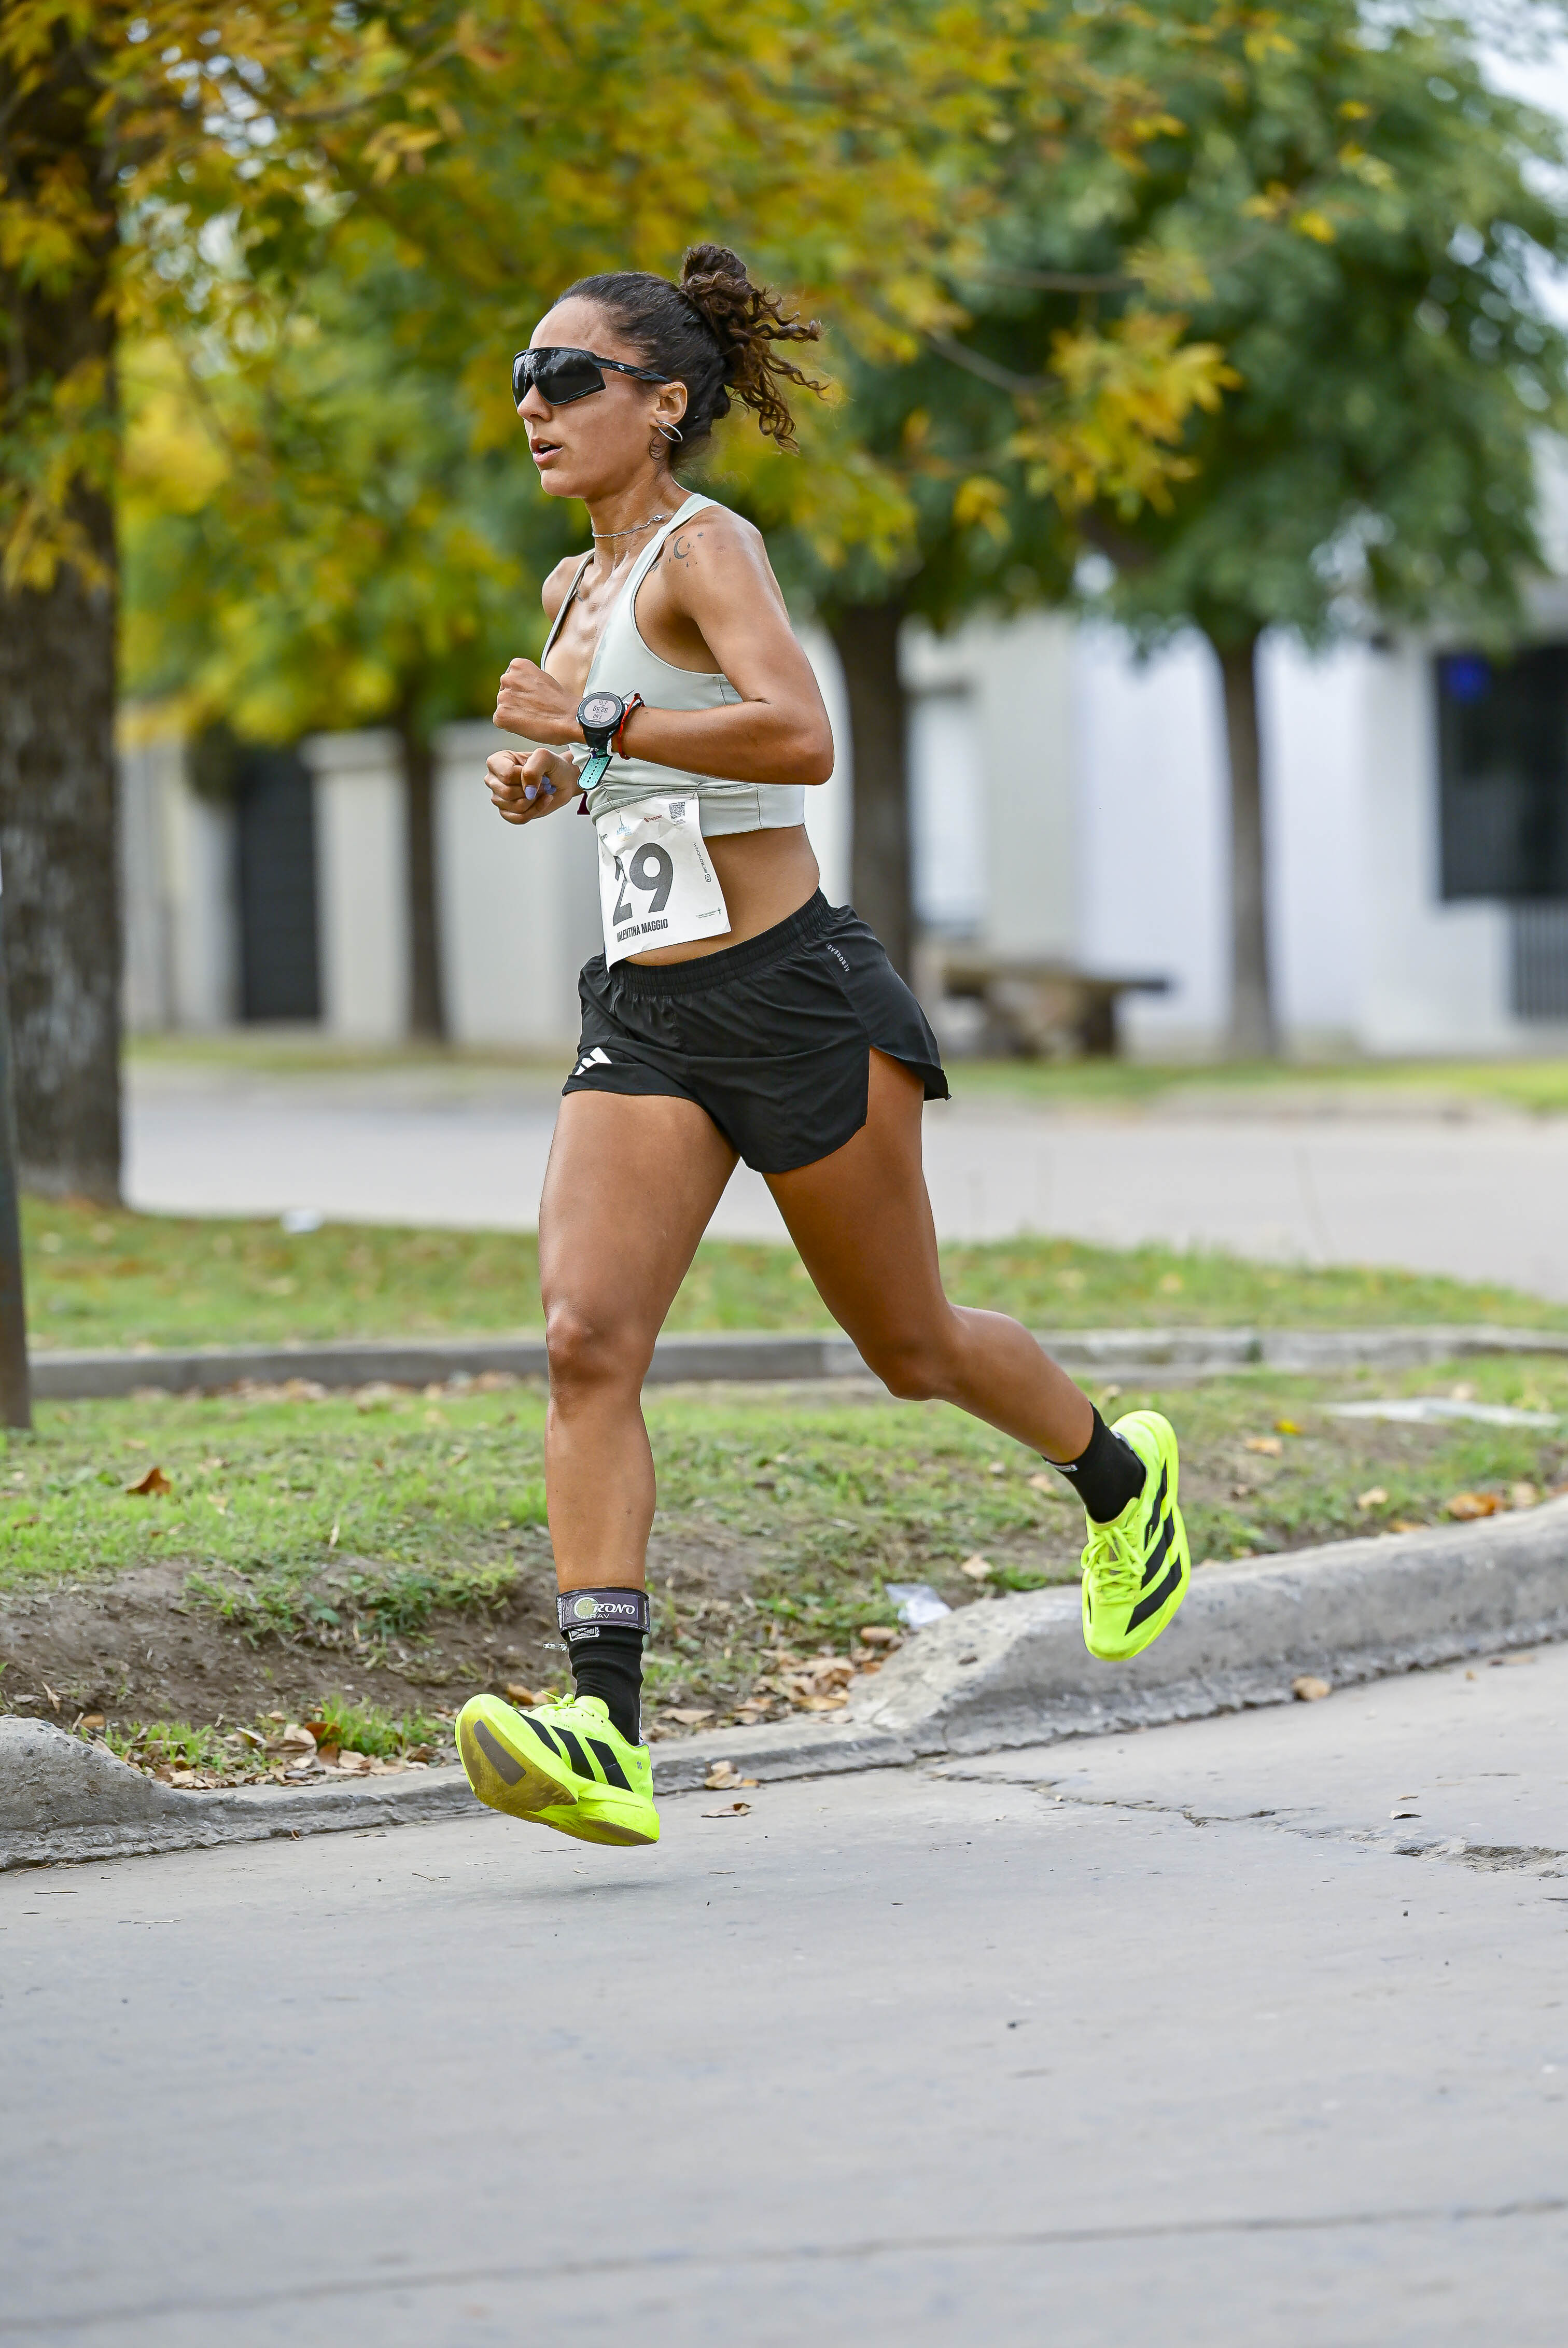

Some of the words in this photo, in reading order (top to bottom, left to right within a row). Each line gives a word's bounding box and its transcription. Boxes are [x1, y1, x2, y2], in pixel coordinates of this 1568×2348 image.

[612, 842, 674, 927] 29
[617, 925, 641, 943] VALENTINA
[641, 918, 668, 934] MAGGIO
